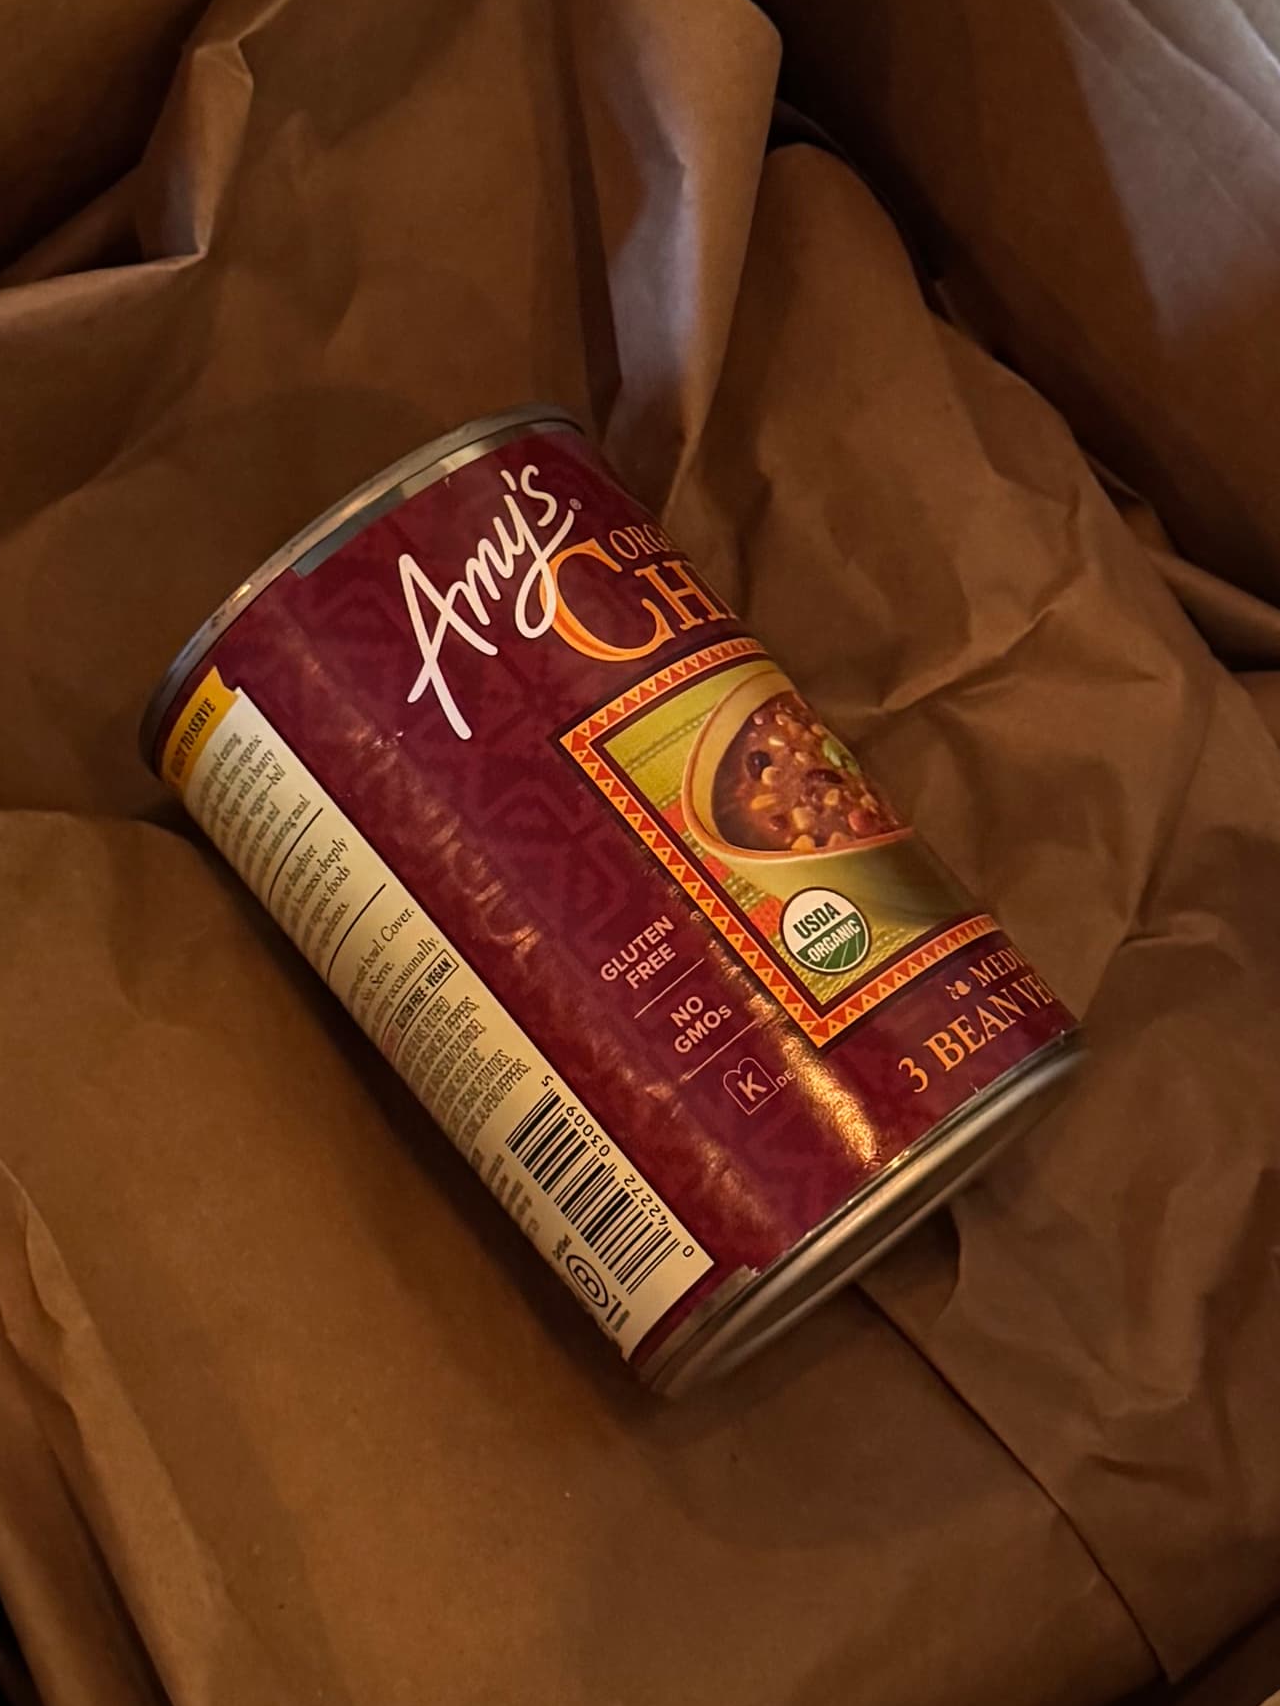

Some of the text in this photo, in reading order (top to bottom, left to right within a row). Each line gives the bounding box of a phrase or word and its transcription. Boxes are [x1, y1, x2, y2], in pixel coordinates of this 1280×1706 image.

[609, 524, 672, 560] ORG
[398, 464, 574, 741] Amy's
[189, 698, 216, 736] SERVE
[238, 734, 262, 766] organic
[249, 750, 276, 778] hearty
[316, 838, 348, 873] deeply
[325, 865, 350, 896] foods
[362, 939, 386, 967] bowl.
[380, 907, 415, 943] Cover.
[793, 901, 841, 940] USDA
[600, 915, 674, 982] GLUTEN
[807, 919, 861, 964] ORGANIC
[370, 961, 395, 989] Serve.
[389, 937, 439, 999] occasionally.
[426, 958, 452, 987] VEGAN
[625, 943, 677, 990] FREE
[670, 996, 704, 1028] NO
[673, 1004, 733, 1054] GMOs
[898, 1057, 929, 1093] 3
[923, 988, 1026, 1072] BEAN
[476, 1049, 512, 1090] POTATOES,
[498, 1058, 531, 1096] PEPPERS.
[737, 1071, 767, 1102] K
[541, 1075, 695, 1258] 0 42272 03009 5
